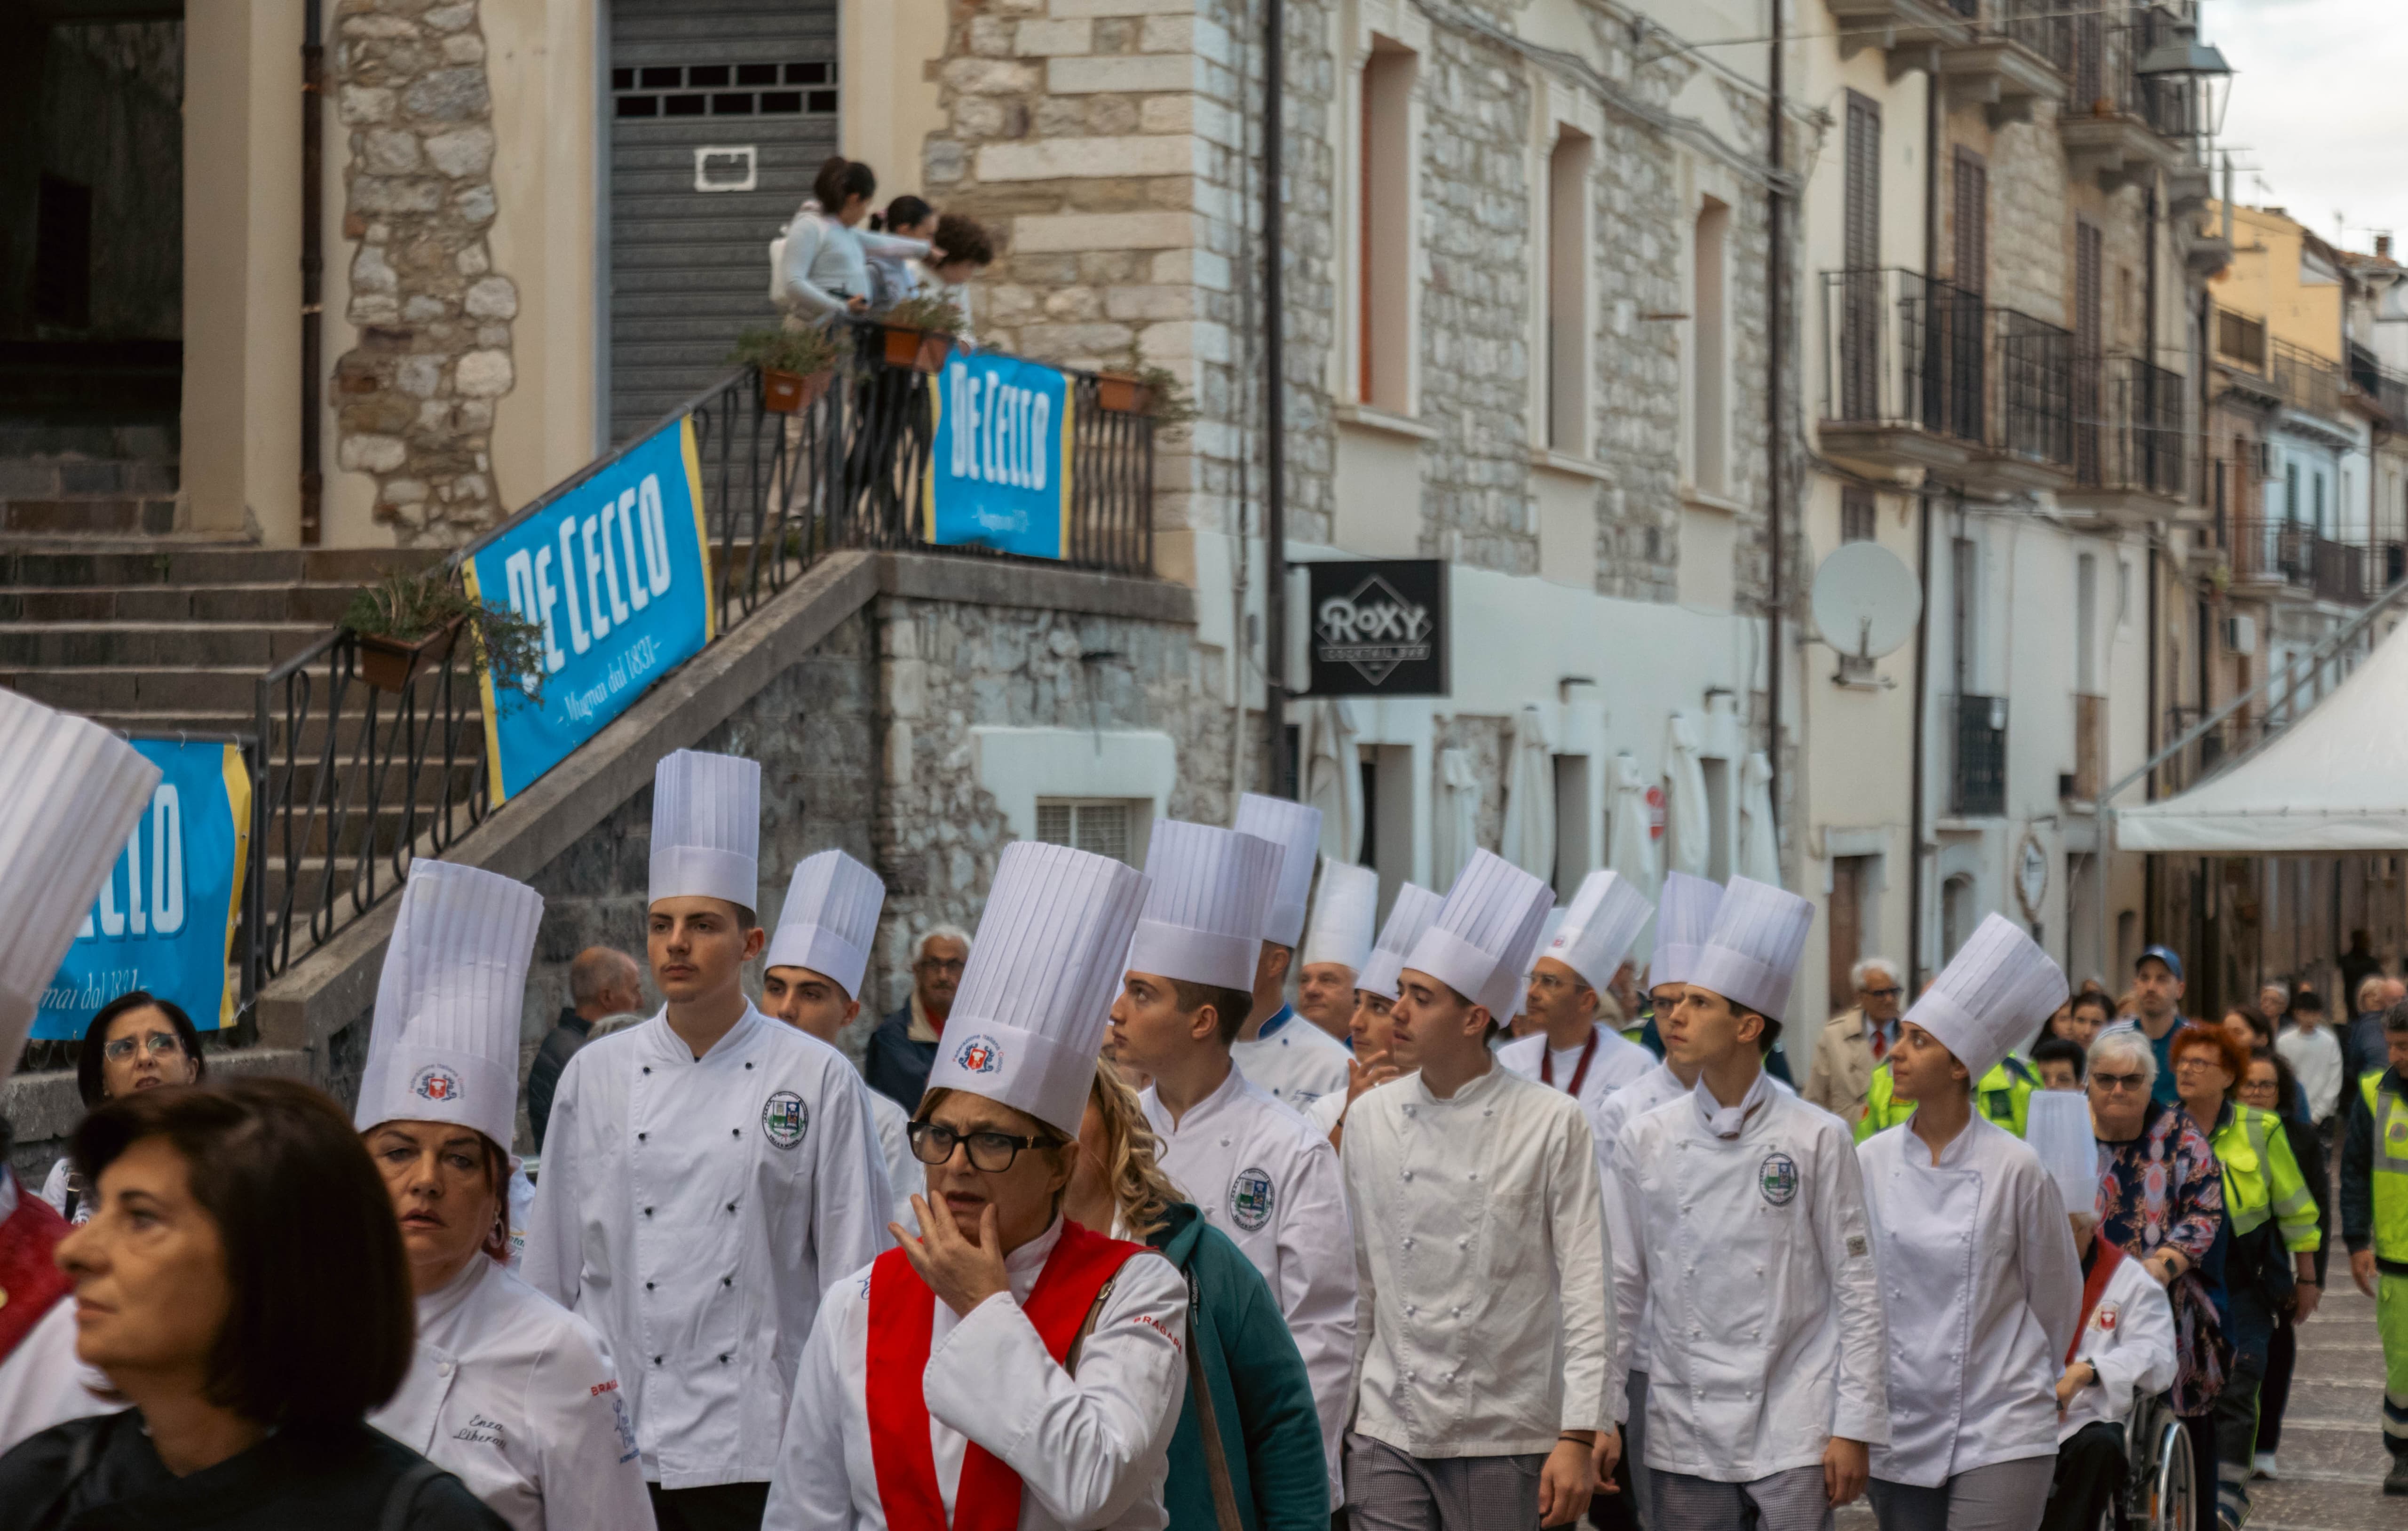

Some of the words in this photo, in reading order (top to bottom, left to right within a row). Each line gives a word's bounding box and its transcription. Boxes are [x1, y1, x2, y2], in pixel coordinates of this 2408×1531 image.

[559, 473, 672, 655] CECCO
[608, 655, 627, 694] dal
[469, 1414, 504, 1432] Enza
